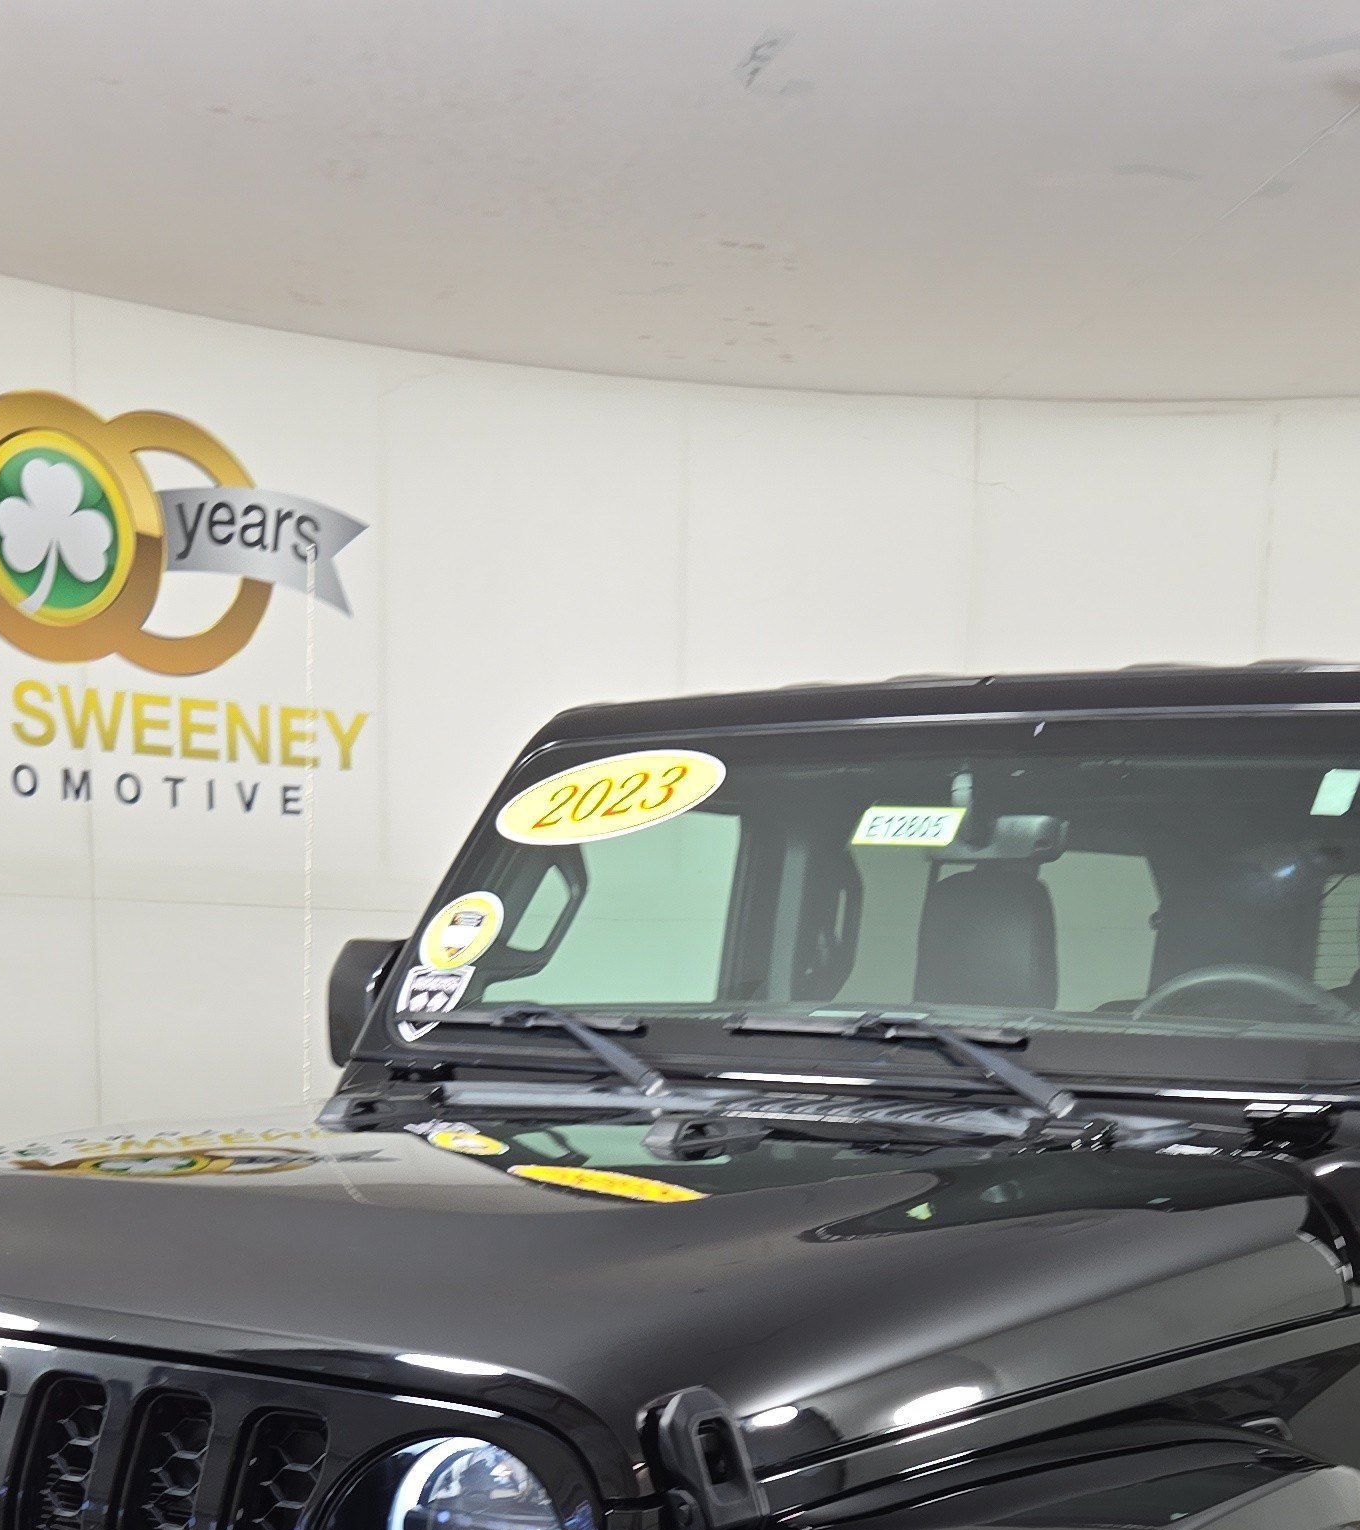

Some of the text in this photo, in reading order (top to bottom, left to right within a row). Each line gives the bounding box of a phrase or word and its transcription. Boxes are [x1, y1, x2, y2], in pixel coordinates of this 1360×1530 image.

[174, 498, 323, 564] years
[11, 678, 370, 772] SWEENEY
[531, 765, 689, 830] 2023
